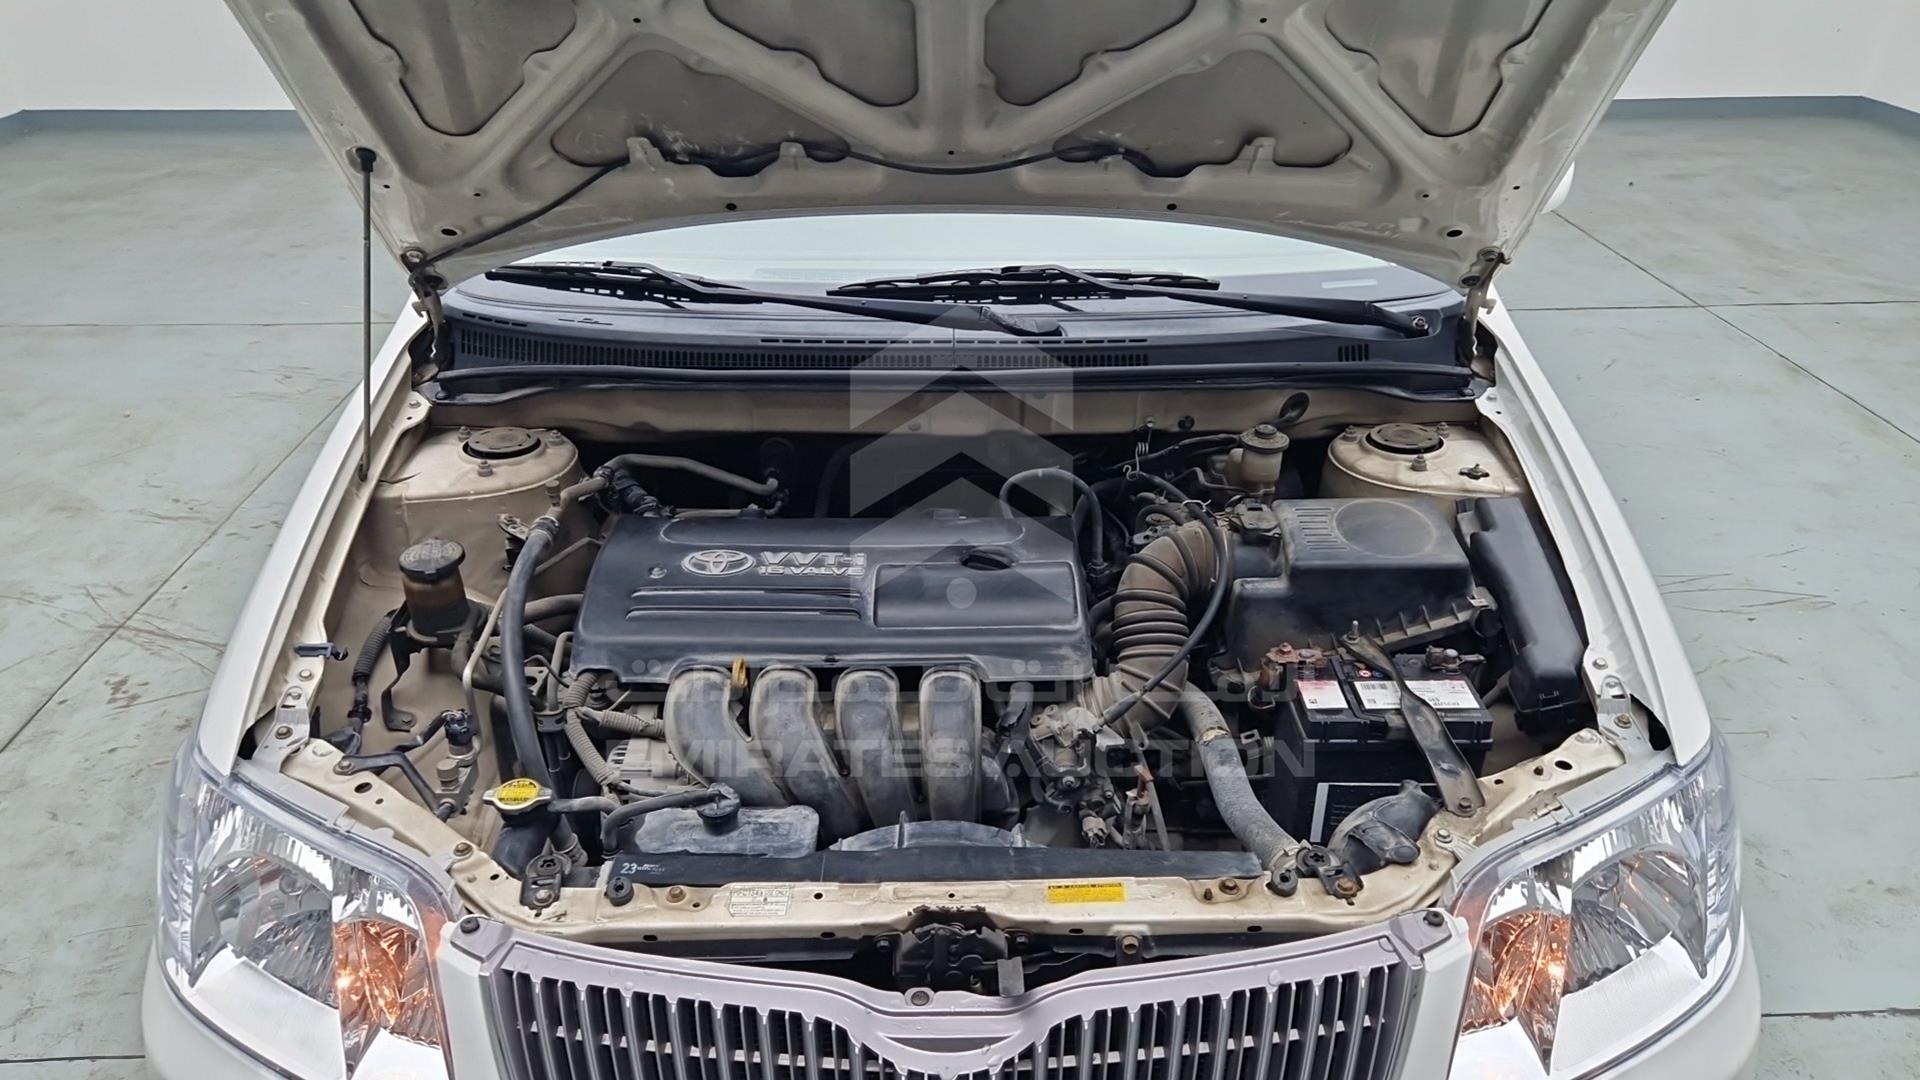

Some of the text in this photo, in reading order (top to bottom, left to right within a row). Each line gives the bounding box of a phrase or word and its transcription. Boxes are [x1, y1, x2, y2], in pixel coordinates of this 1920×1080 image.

[758, 565, 865, 577] 16 VALVE
[620, 862, 638, 875] 23
